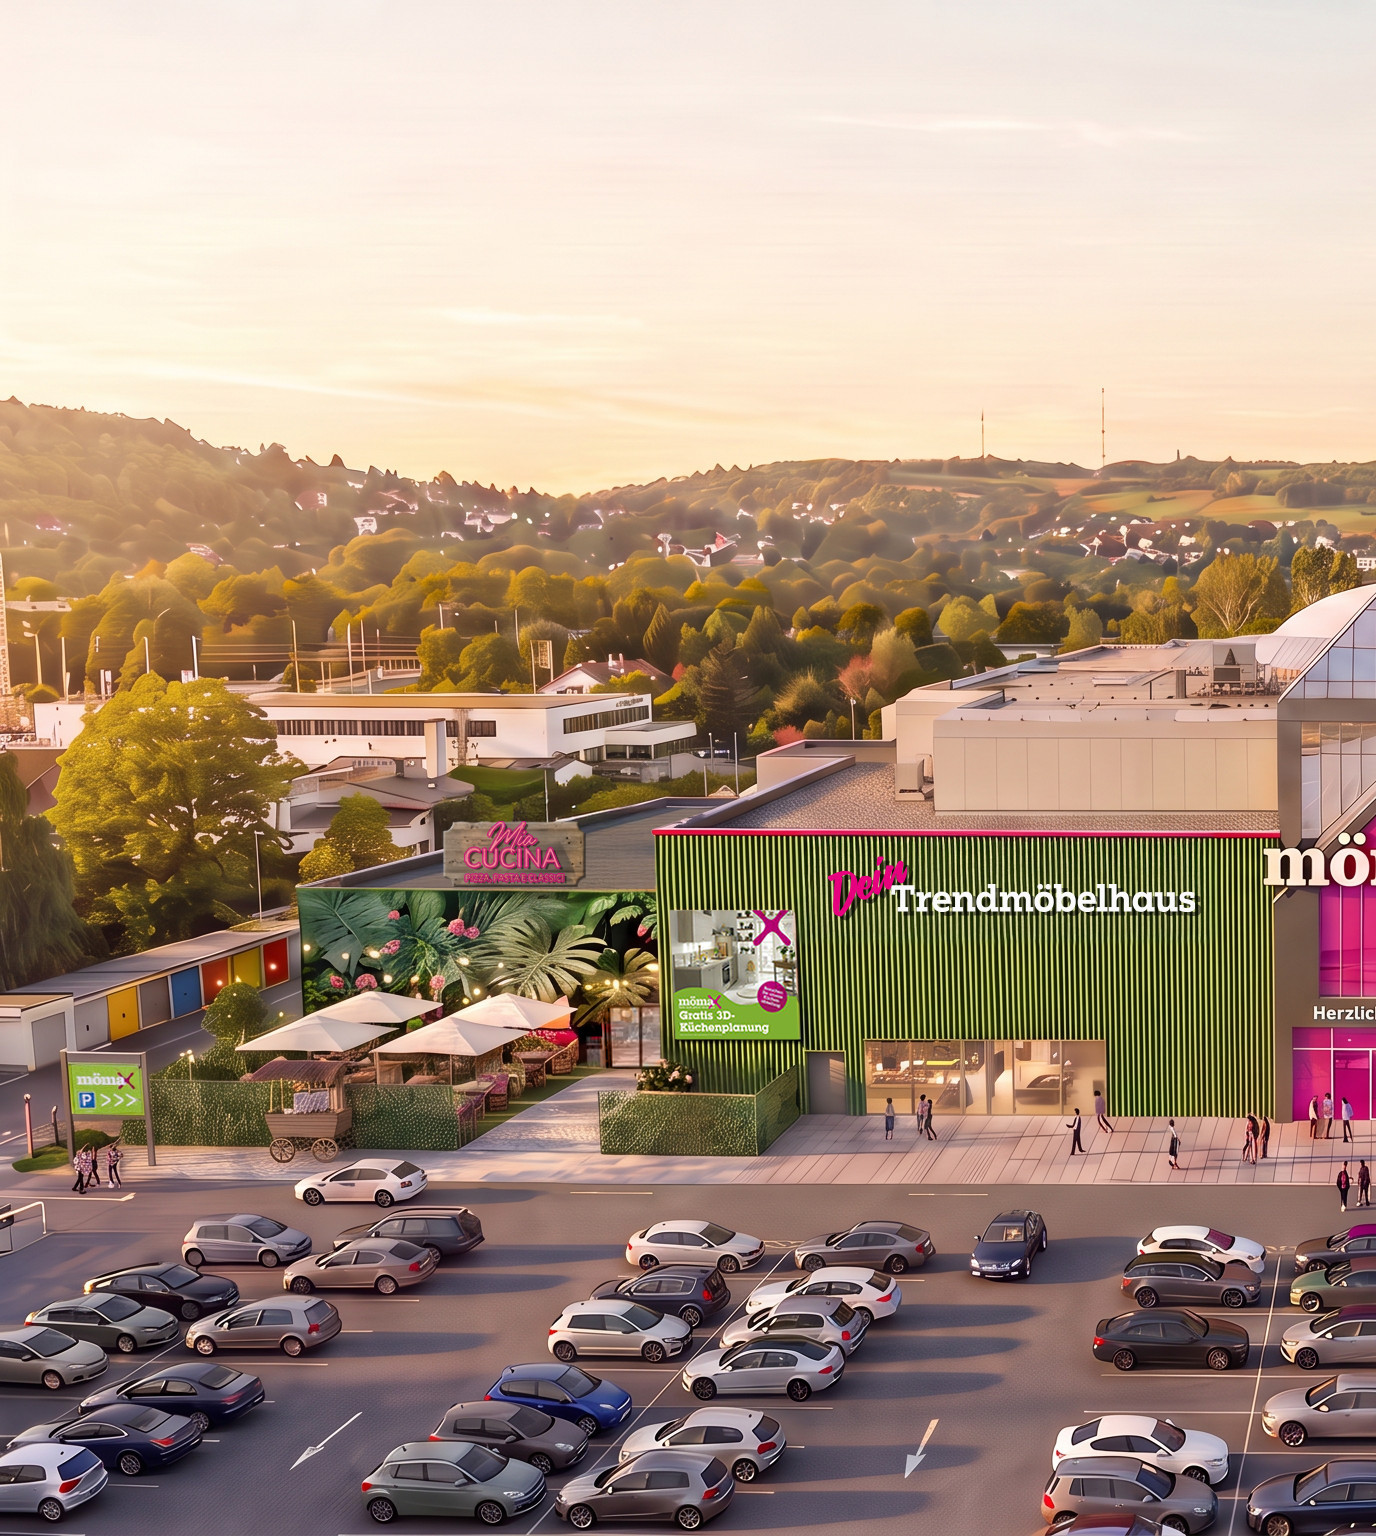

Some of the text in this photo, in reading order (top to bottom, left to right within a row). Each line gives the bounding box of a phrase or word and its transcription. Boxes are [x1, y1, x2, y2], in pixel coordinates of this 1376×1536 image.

[487, 820, 538, 855] Mia
[464, 846, 561, 869] CUCINA
[493, 872, 520, 884] PASTA
[828, 856, 907, 917] Dein
[891, 883, 1196, 913] Trendmöbelhaus
[679, 1010, 735, 1020] Gratis 3D-
[680, 1022, 769, 1035] Küchenplanung
[82, 1094, 92, 1107] P
